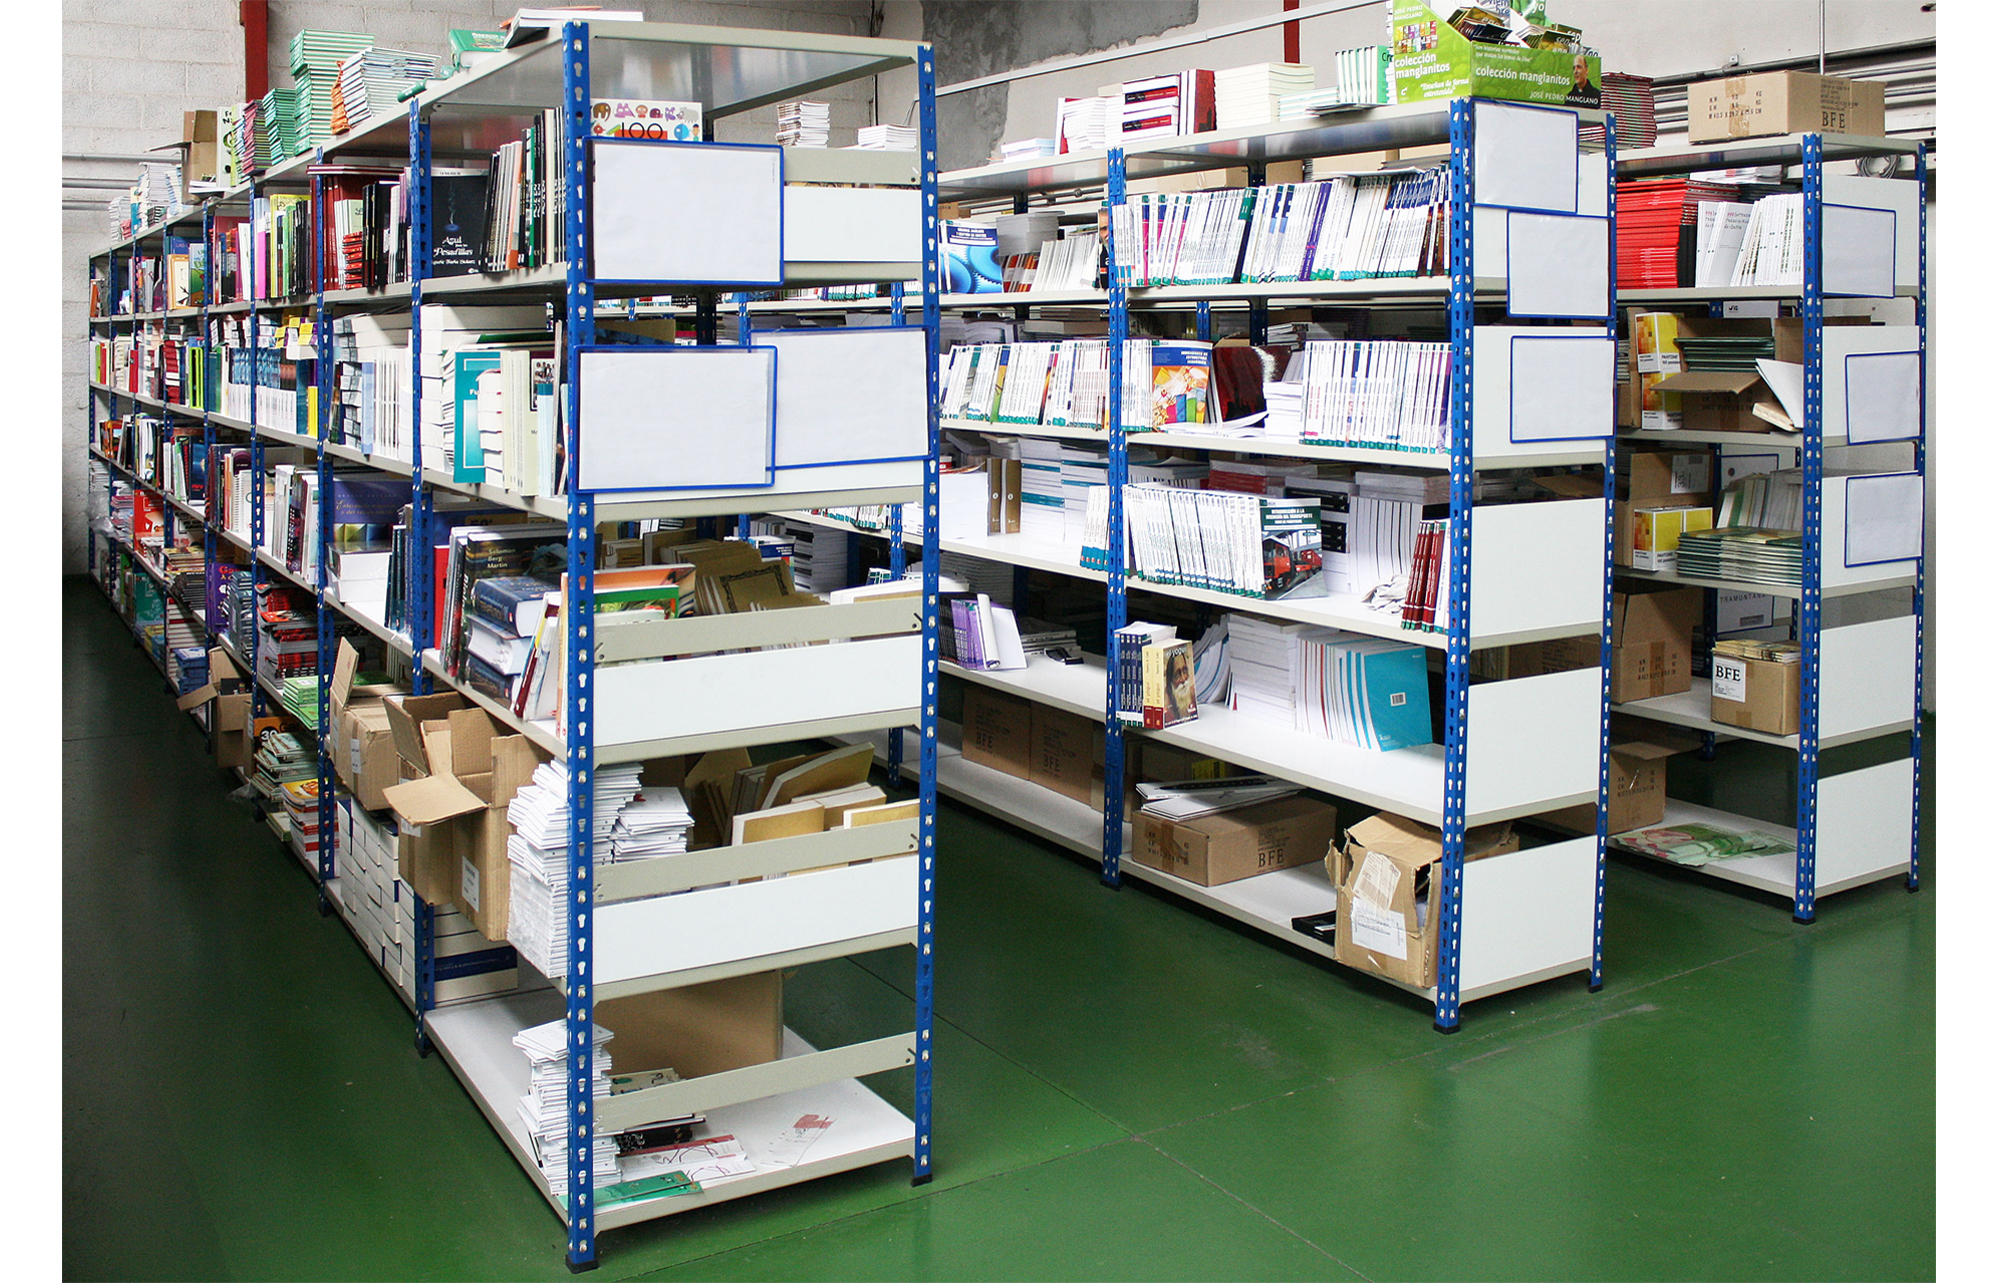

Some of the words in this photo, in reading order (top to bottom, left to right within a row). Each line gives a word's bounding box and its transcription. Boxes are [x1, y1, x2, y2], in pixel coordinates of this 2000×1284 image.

[1395, 52, 1436, 67] colección
[1396, 63, 1450, 79] manglanitos
[1476, 66, 1517, 79] colección
[1520, 72, 1570, 85] manglanitos
[1530, 90, 1544, 99] JOSÉ
[1566, 95, 1599, 104] MANGLANO
[1822, 111, 1846, 128] BFE
[622, 122, 663, 139] 100
[1716, 665, 1741, 682] BFE
[1258, 849, 1284, 868] BFE
